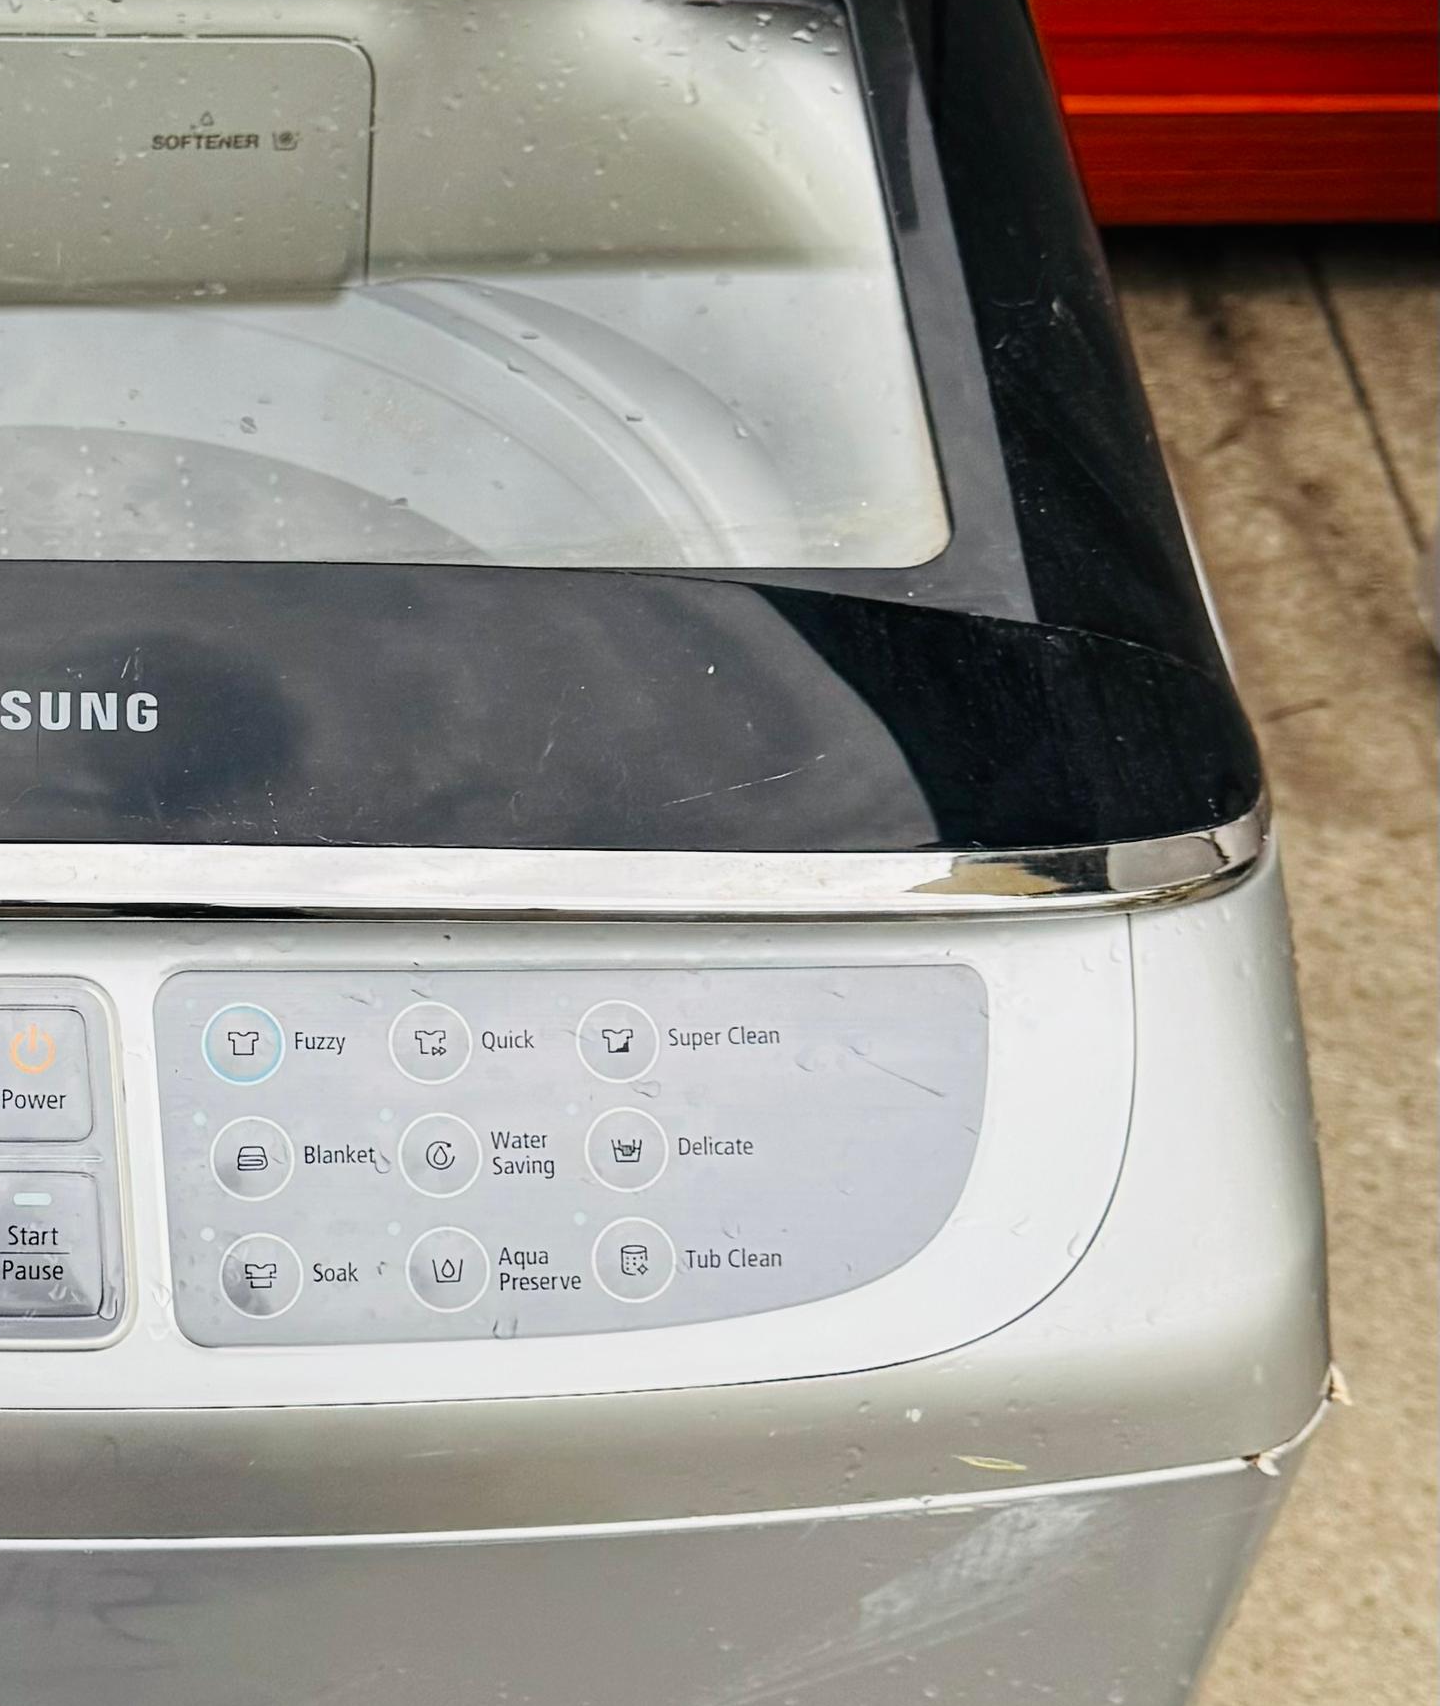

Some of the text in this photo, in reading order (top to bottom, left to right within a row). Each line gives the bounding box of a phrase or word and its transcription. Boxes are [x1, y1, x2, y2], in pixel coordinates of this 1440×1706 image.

[152, 133, 260, 150] SOFTENER
[294, 1031, 346, 1055] Fuzzy
[481, 1030, 535, 1052] Quick
[668, 1025, 780, 1051] Super Clean
[2, 1088, 66, 1110] Power
[490, 1131, 547, 1150] Water
[678, 1135, 754, 1156] Delicate
[304, 1144, 376, 1165] Blanket
[492, 1155, 555, 1180] Saving
[8, 1225, 59, 1246] Start
[498, 1246, 549, 1270] Aqua
[685, 1248, 782, 1269] Tub Clean
[2, 1259, 64, 1281] Pause
[312, 1262, 358, 1283] Soak
[499, 1271, 582, 1291] Preserve
